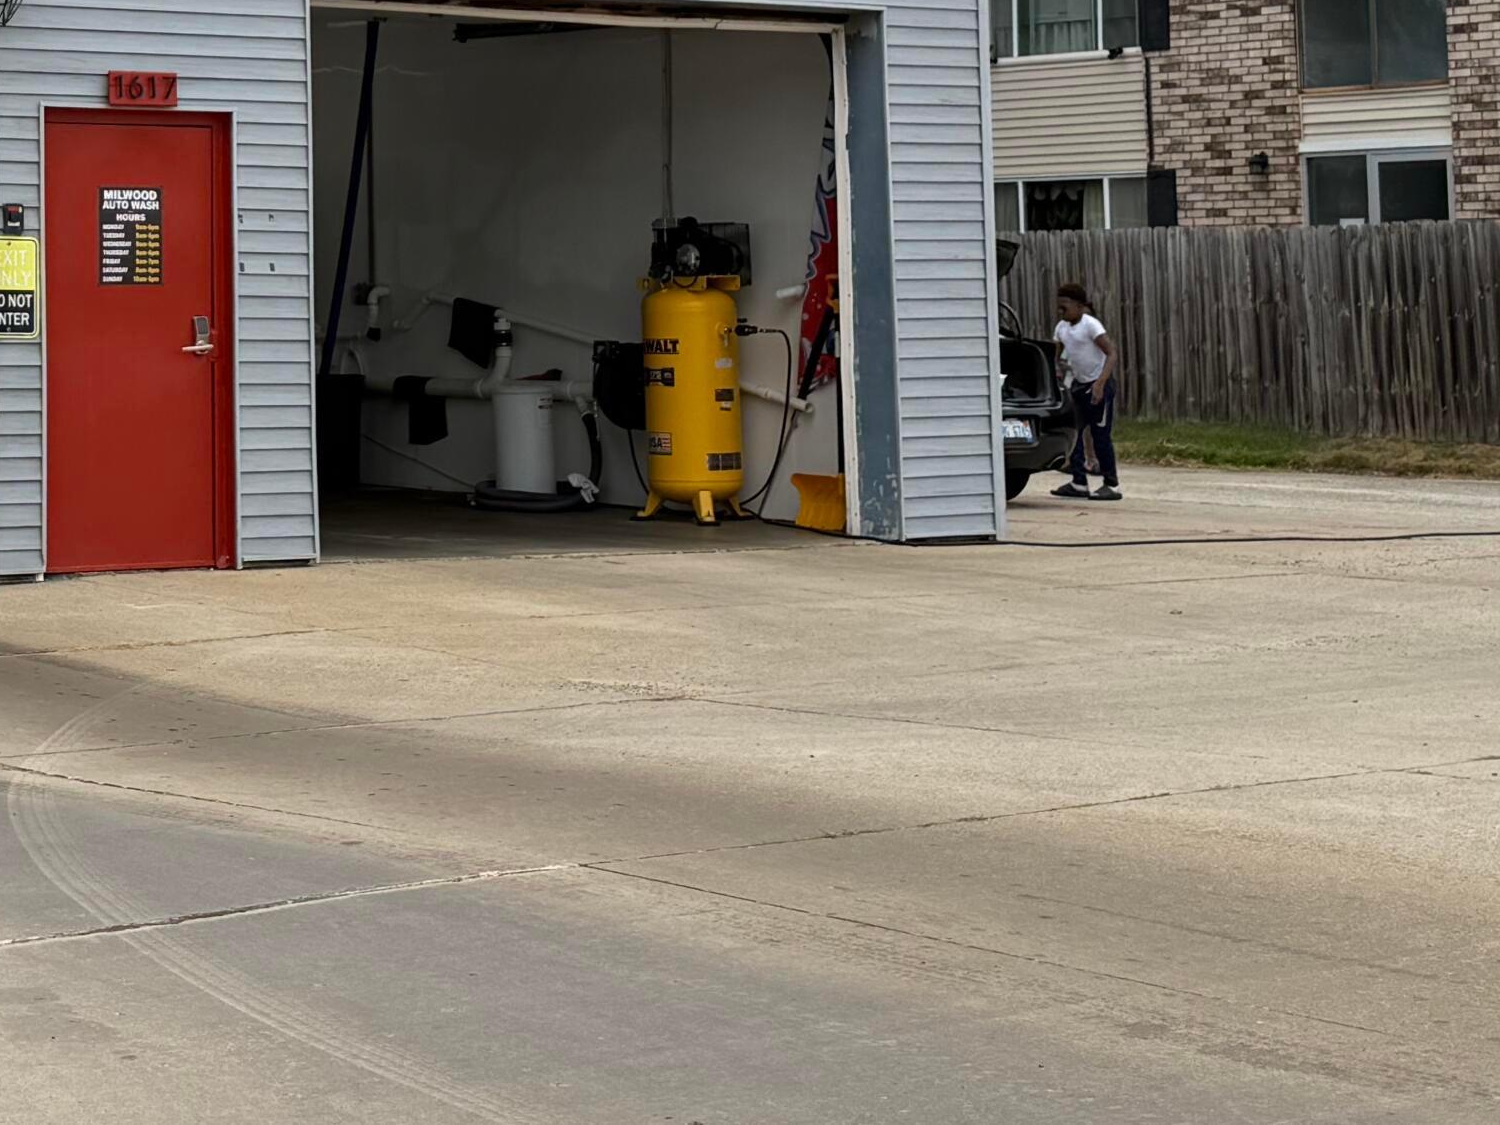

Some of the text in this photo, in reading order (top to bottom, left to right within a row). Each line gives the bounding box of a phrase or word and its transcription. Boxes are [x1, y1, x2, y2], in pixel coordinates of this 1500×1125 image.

[112, 75, 177, 100] 1617
[103, 189, 158, 201] MILWOOD
[102, 200, 160, 211] AUTO WASH
[116, 213, 147, 222] HOURS
[8, 293, 32, 308] NOT
